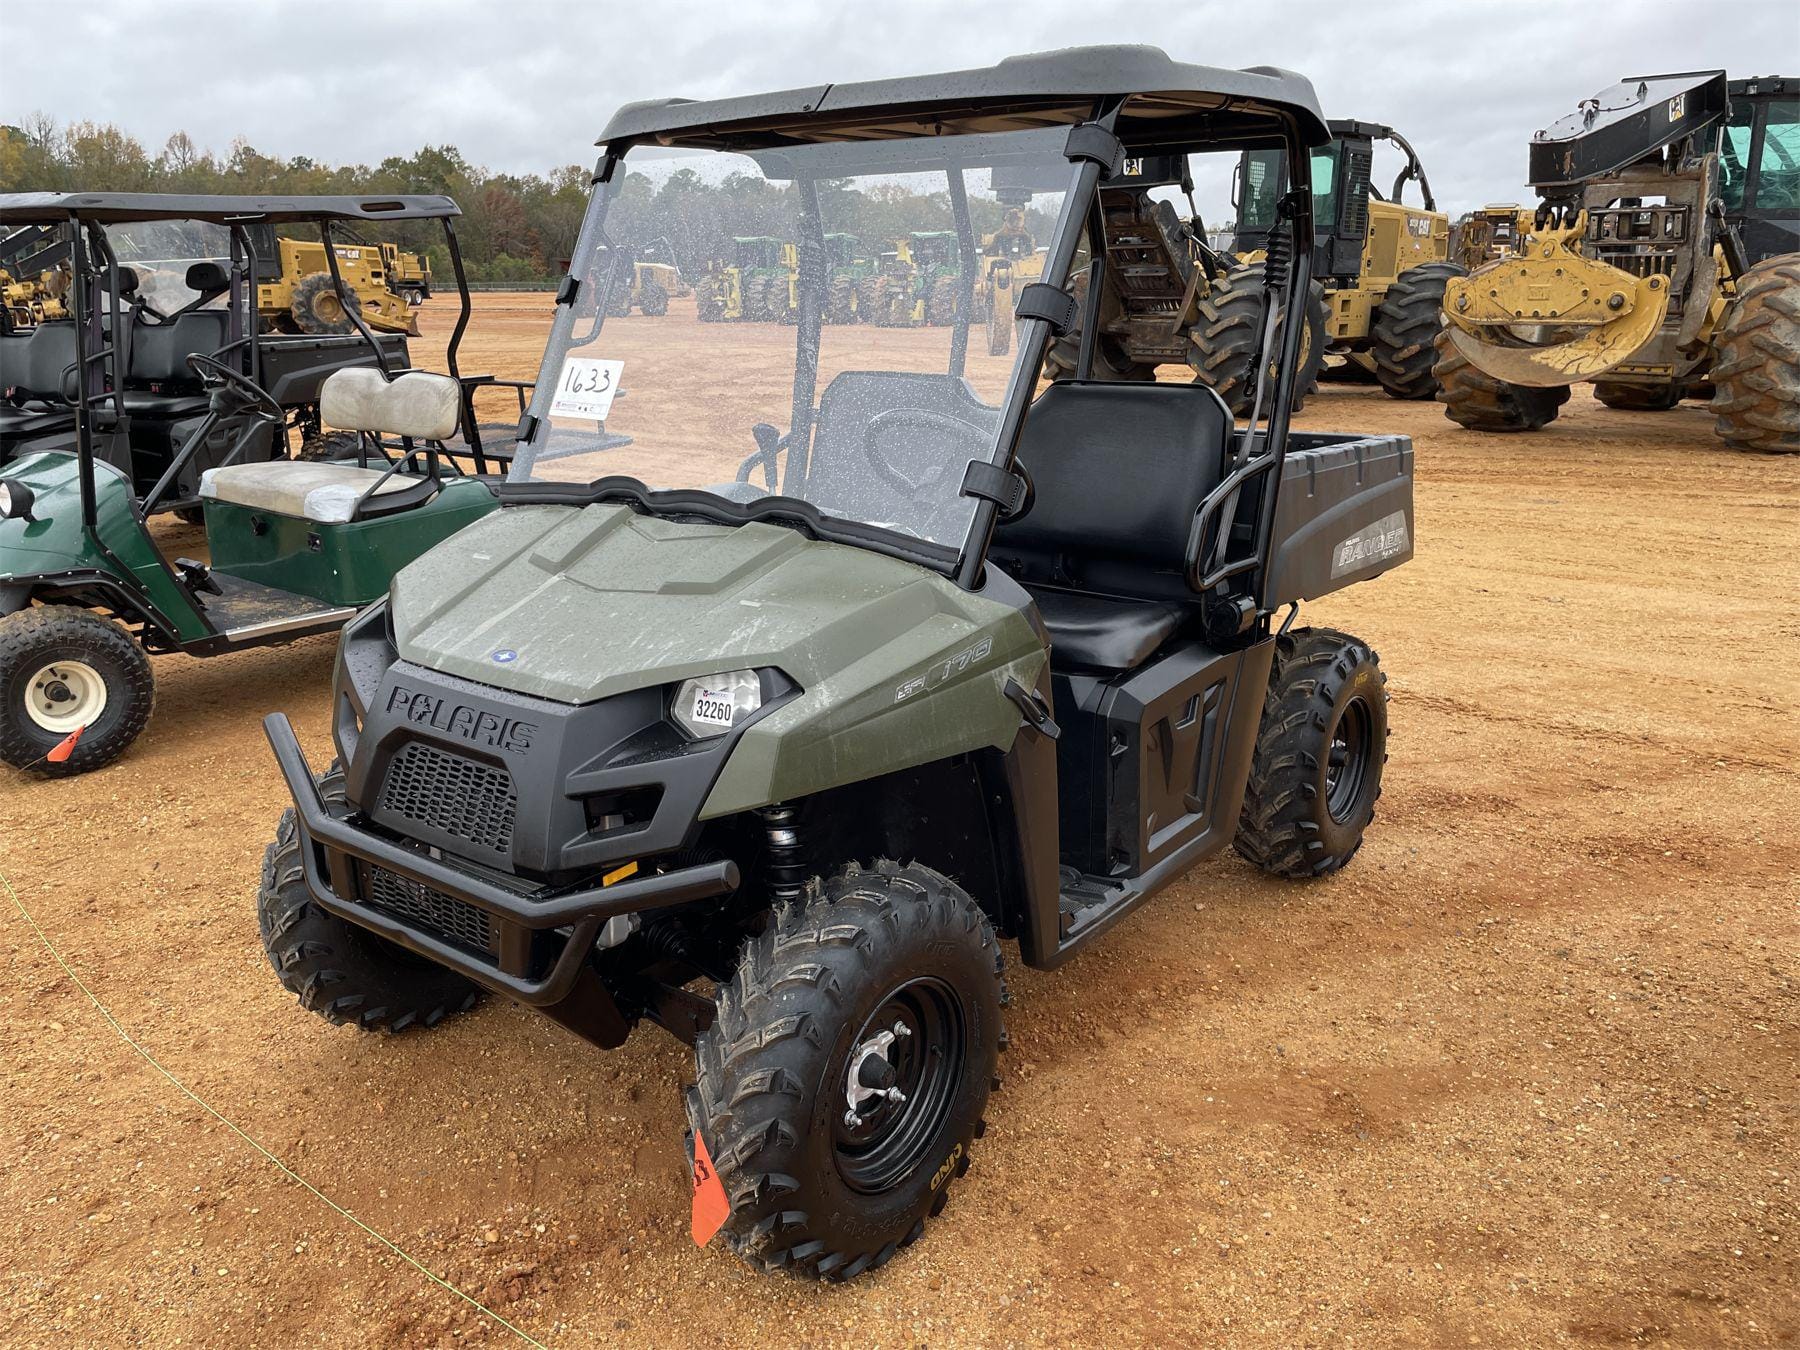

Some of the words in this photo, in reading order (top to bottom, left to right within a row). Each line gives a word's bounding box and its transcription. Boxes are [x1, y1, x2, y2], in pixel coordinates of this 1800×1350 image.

[1669, 93, 1686, 122] CAT
[1123, 158, 1144, 176] CAT
[565, 366, 610, 393] 1633
[386, 686, 539, 755] POLARIS
[696, 699, 731, 721] 32260
